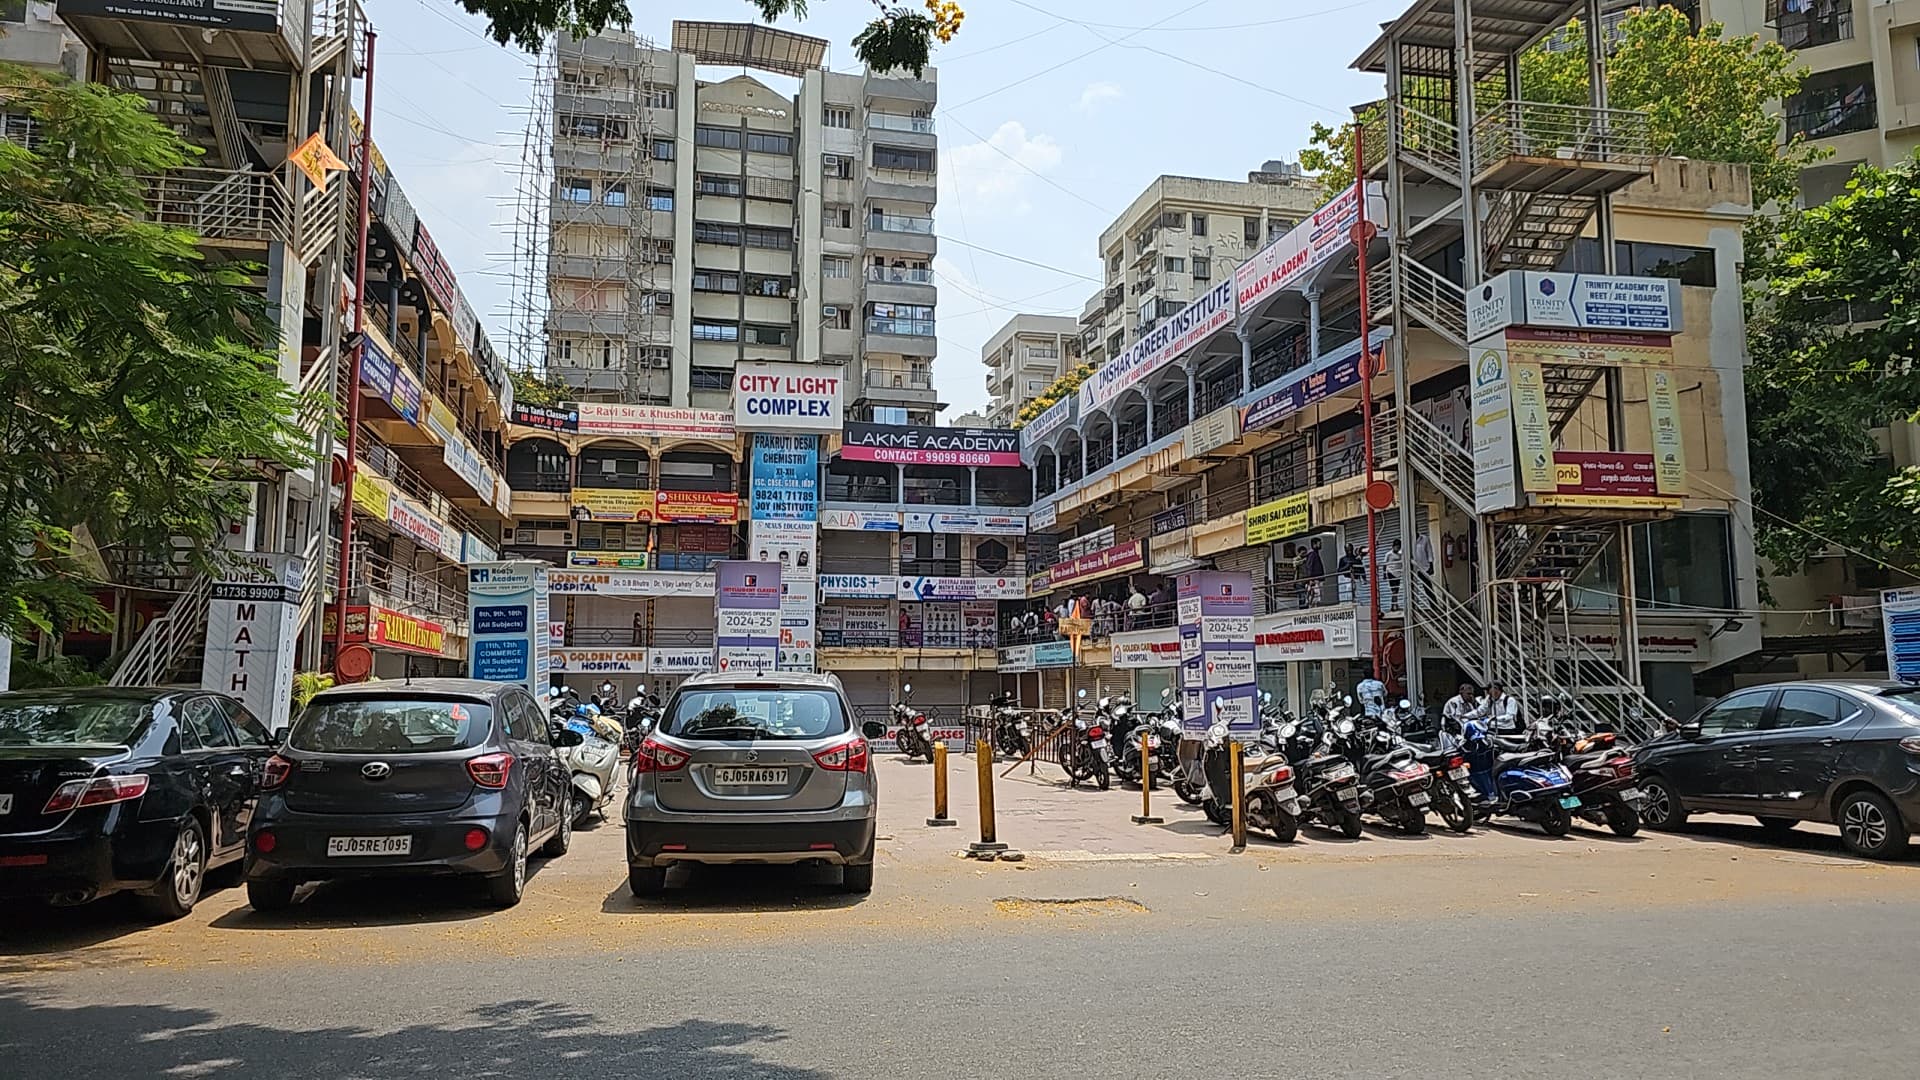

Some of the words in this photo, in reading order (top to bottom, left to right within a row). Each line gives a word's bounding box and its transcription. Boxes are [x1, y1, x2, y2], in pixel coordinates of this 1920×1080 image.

[1240, 275, 1268, 304] GALAXY
[1271, 248, 1308, 285] ACADEMY
[1585, 281, 1612, 290] TRINITY
[1614, 282, 1650, 291] ACADEMY
[1651, 284, 1666, 292] FOR
[1530, 299, 1567, 308] TRINITY
[1633, 294, 1662, 302] BOARDS
[1471, 296, 1506, 316] TRINITY
[1098, 349, 1131, 389] IMSHAR
[1133, 326, 1168, 365] CAREER
[1171, 279, 1230, 340] INSTITUTE
[1188, 325, 1206, 345] PHYSICS
[1212, 310, 1228, 327] MATHS
[367, 348, 392, 378] INTELLECT
[363, 360, 391, 394] COMPUTERS
[739, 374, 780, 392] CITY
[786, 377, 838, 395] LIGHT
[1478, 395, 1502, 406] HOSPITAL
[530, 406, 546, 416] Tank
[546, 409, 568, 420] Classes
[747, 398, 831, 417] COMPLEX
[520, 414, 528, 422] IB
[529, 415, 546, 425] MYP
[554, 418, 564, 428] DP
[596, 406, 618, 418] Ravi
[622, 407, 636, 418] Sir
[638, 409, 646, 418] &
[650, 408, 696, 420] Khushbu
[700, 412, 734, 423] Ma'am
[755, 435, 792, 450] PRAKRUTI
[794, 436, 816, 450] DESAI
[848, 431, 918, 448] LAKMÉ
[924, 436, 1016, 452] ACADEMY
[763, 453, 808, 464] CHEMISTRY
[874, 450, 918, 462] CONTACT
[926, 453, 957, 464] 99099
[959, 454, 990, 464] 80660
[776, 468, 794, 476] XI-XII
[1557, 468, 1579, 482] pnb
[668, 492, 712, 502] SHIKSHA
[756, 490, 782, 501] 98241
[787, 491, 814, 502] 71789
[756, 502, 770, 512] JOY
[773, 502, 814, 512] INSTITUTE
[1249, 513, 1268, 528] SHRRI
[1270, 510, 1280, 522] SAI
[1282, 503, 1308, 519] XEROX
[392, 506, 408, 526] BYTE
[408, 518, 440, 546] COMPUTERS
[784, 522, 814, 530] EDUCATION
[222, 572, 278, 584] JUNEJA
[492, 575, 528, 584] Academy
[582, 574, 610, 584] CARE
[662, 580, 674, 588] Vijay
[216, 586, 247, 598] 91736
[250, 588, 280, 599] 99909
[549, 583, 598, 592] HOSPITAL
[478, 621, 490, 630] (All
[492, 620, 523, 630] Subjects)
[726, 616, 772, 626] 2024-25
[385, 614, 417, 646] SAINATH
[416, 628, 430, 648] FAST
[430, 631, 442, 650] FOOD
[1209, 624, 1248, 633] 2024-25
[478, 658, 490, 666] (All
[570, 652, 612, 661] GOLDEN
[616, 653, 643, 662] CARE
[668, 656, 698, 667] MANOJ
[1127, 654, 1148, 662] HOSPITAL
[582, 662, 631, 670] HOSPITAL
[722, 770, 788, 784] GJ05RA6917
[336, 838, 409, 854] GJ05RE1095
